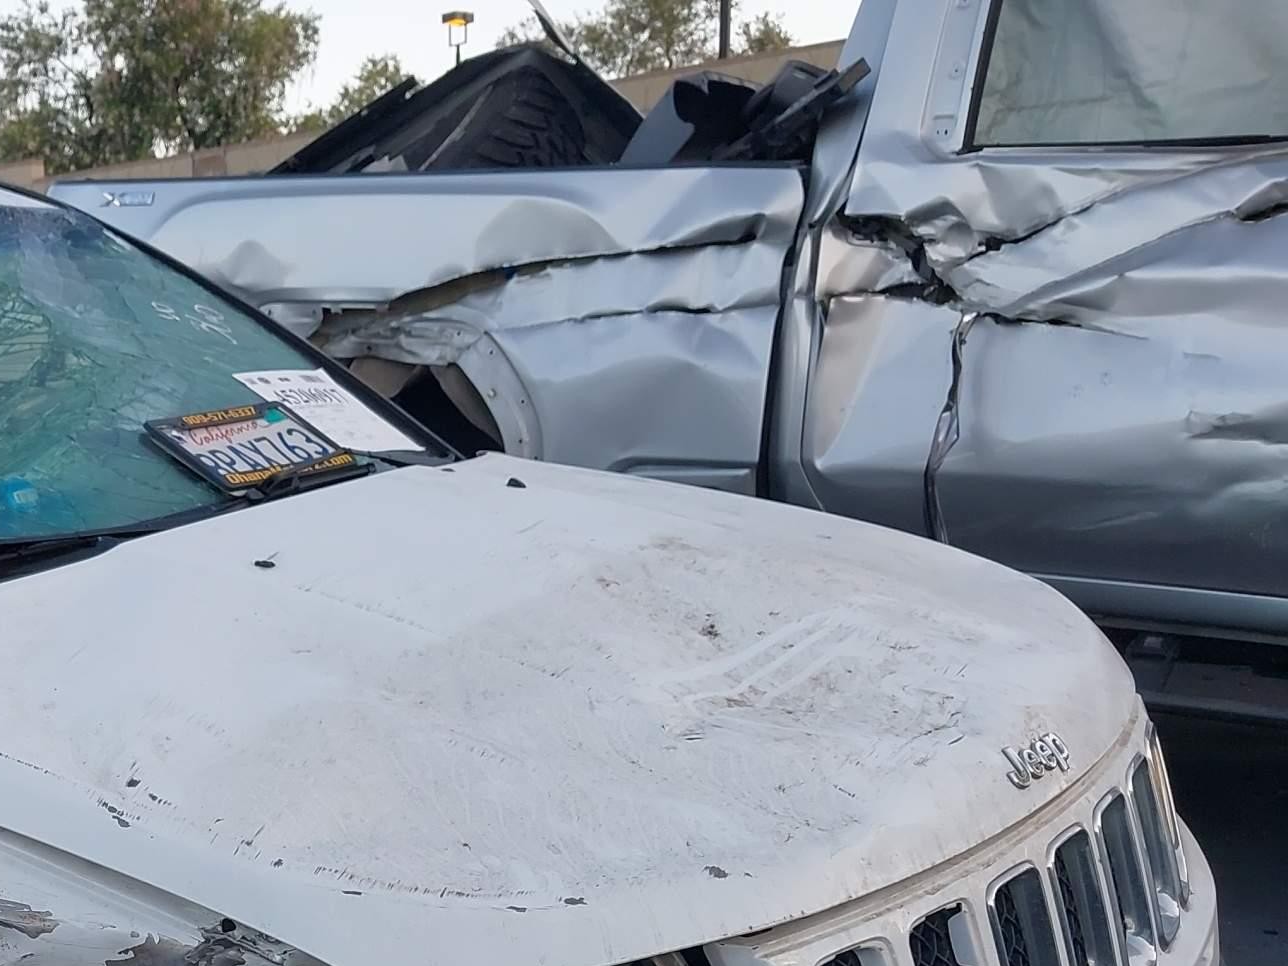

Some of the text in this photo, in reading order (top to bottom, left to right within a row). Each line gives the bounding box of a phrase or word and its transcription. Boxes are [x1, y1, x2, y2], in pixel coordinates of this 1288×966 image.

[182, 406, 256, 425] 909-571-6337
[188, 421, 261, 446] California
[1001, 732, 1070, 790] Jeep
